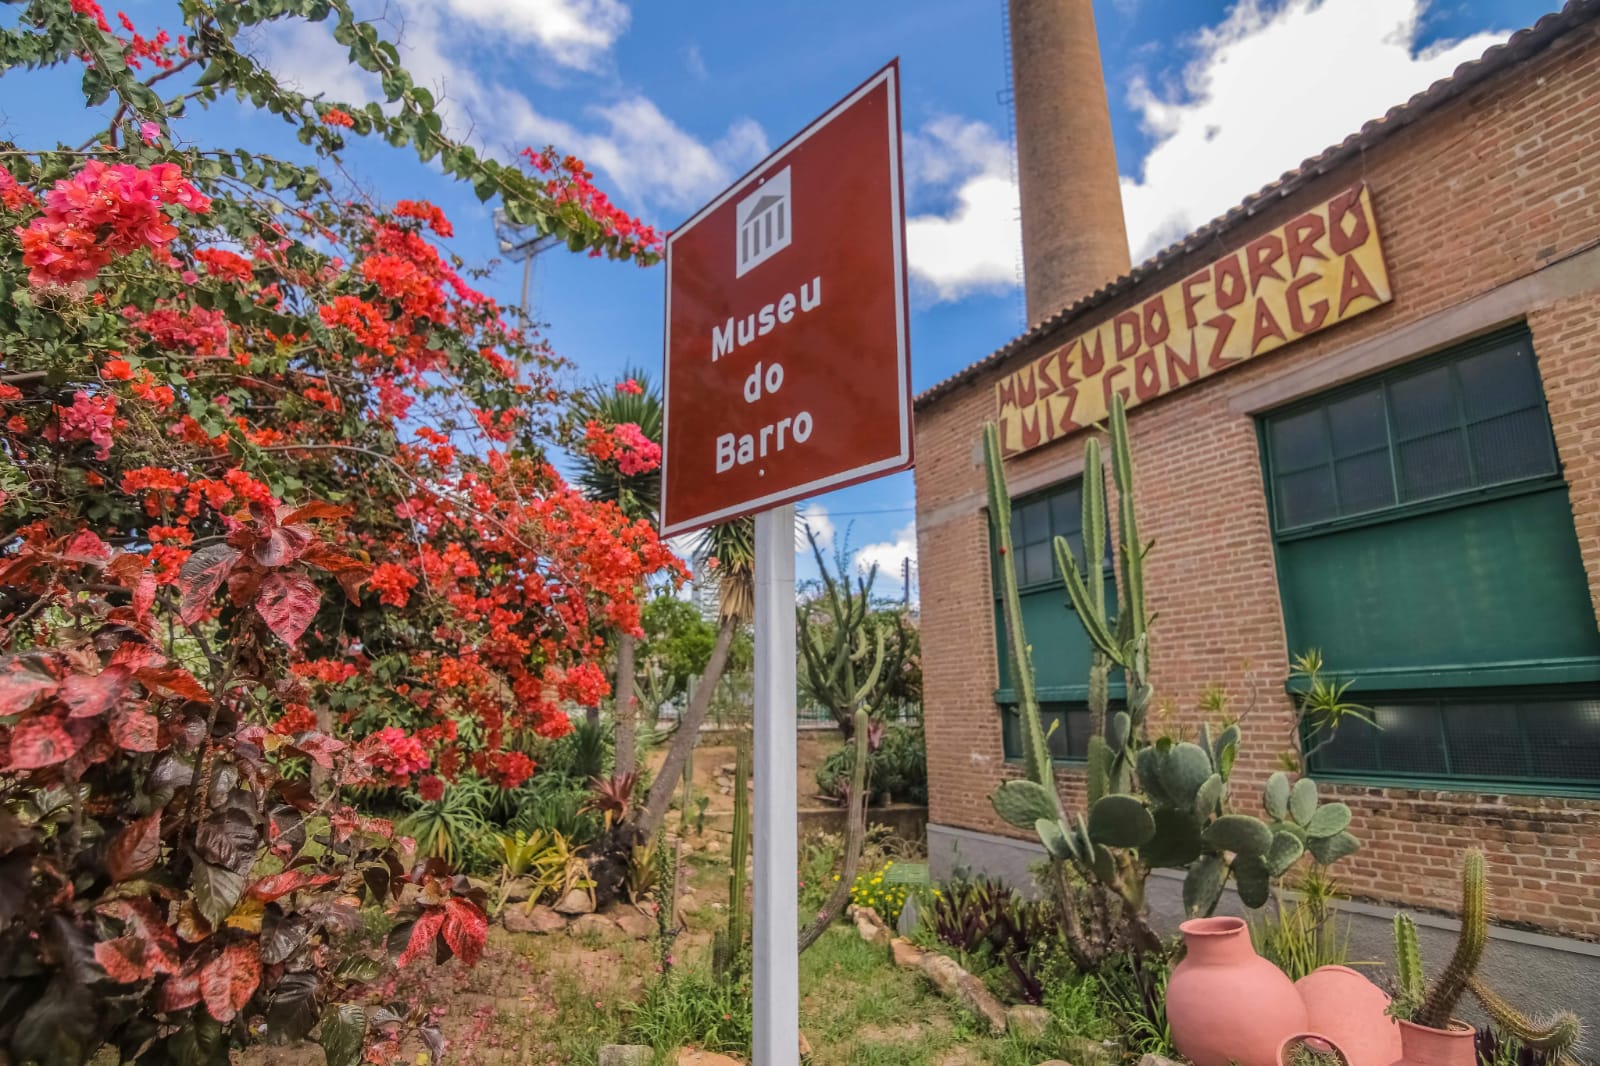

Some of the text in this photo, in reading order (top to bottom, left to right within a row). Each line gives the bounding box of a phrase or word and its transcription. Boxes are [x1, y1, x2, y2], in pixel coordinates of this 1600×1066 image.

[712, 276, 821, 362] Museu
[1000, 183, 1370, 409] MUSEU DO FORRÓ
[744, 361, 784, 403] do
[1000, 254, 1383, 455] LUIZ GONZAGA
[716, 411, 813, 474] Barro
